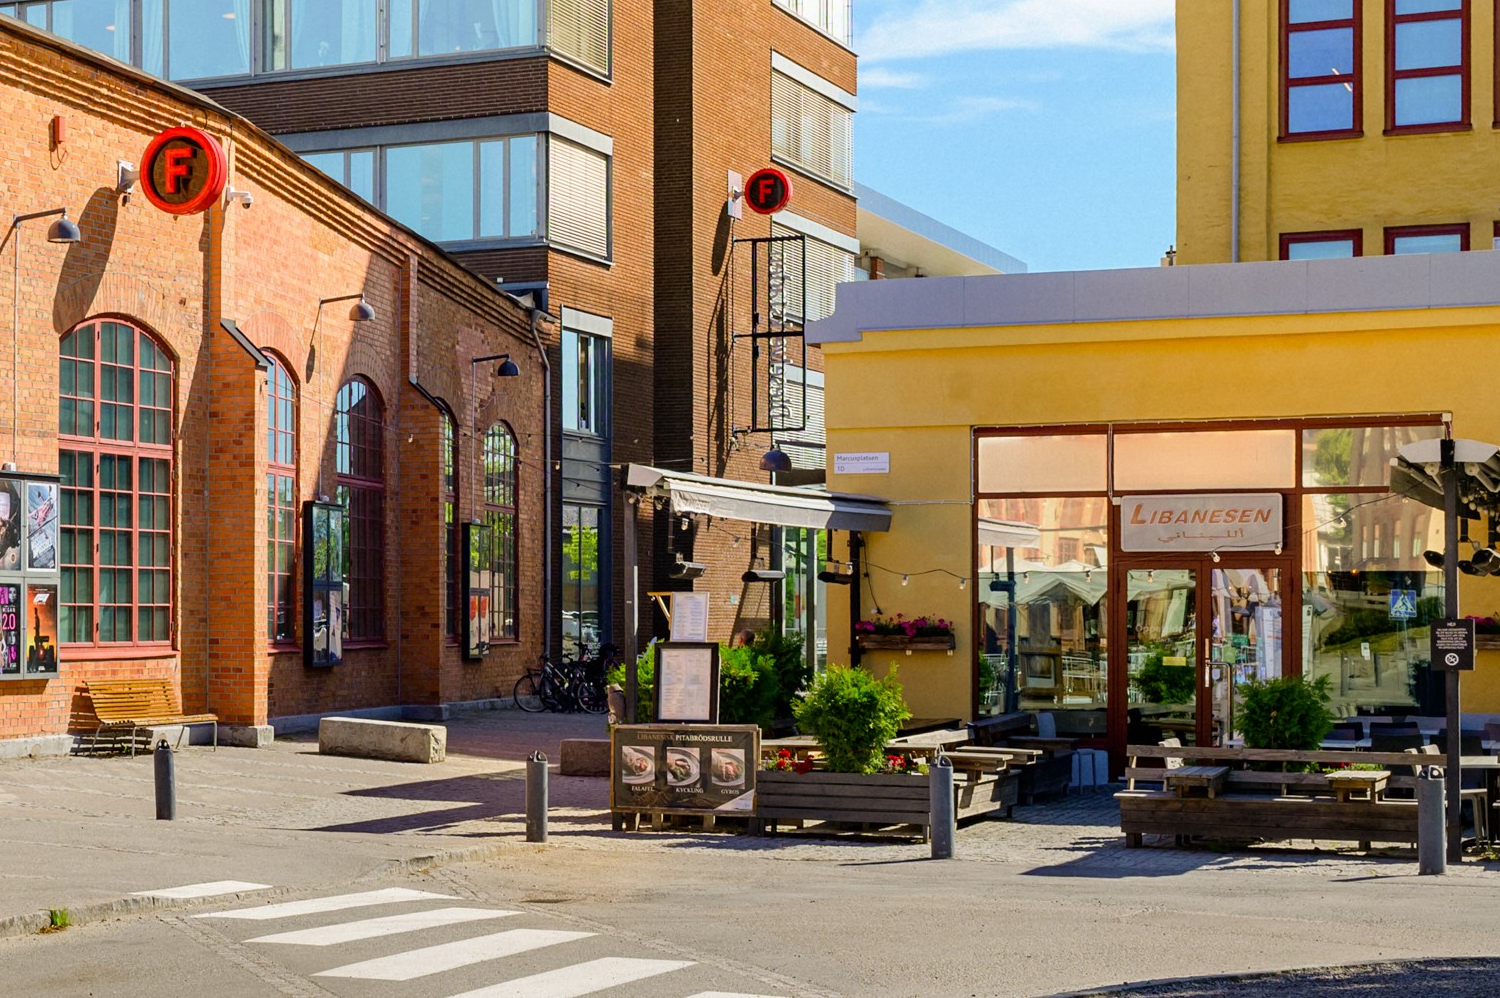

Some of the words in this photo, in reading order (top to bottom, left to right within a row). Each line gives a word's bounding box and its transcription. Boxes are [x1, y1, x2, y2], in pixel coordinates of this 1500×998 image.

[165, 147, 192, 194] F
[759, 179, 775, 204] F
[1130, 503, 1272, 525] LIBANESEN
[2, 613, 16, 630] 2.0
[675, 734, 733, 742] PITABRÖDSRULLE
